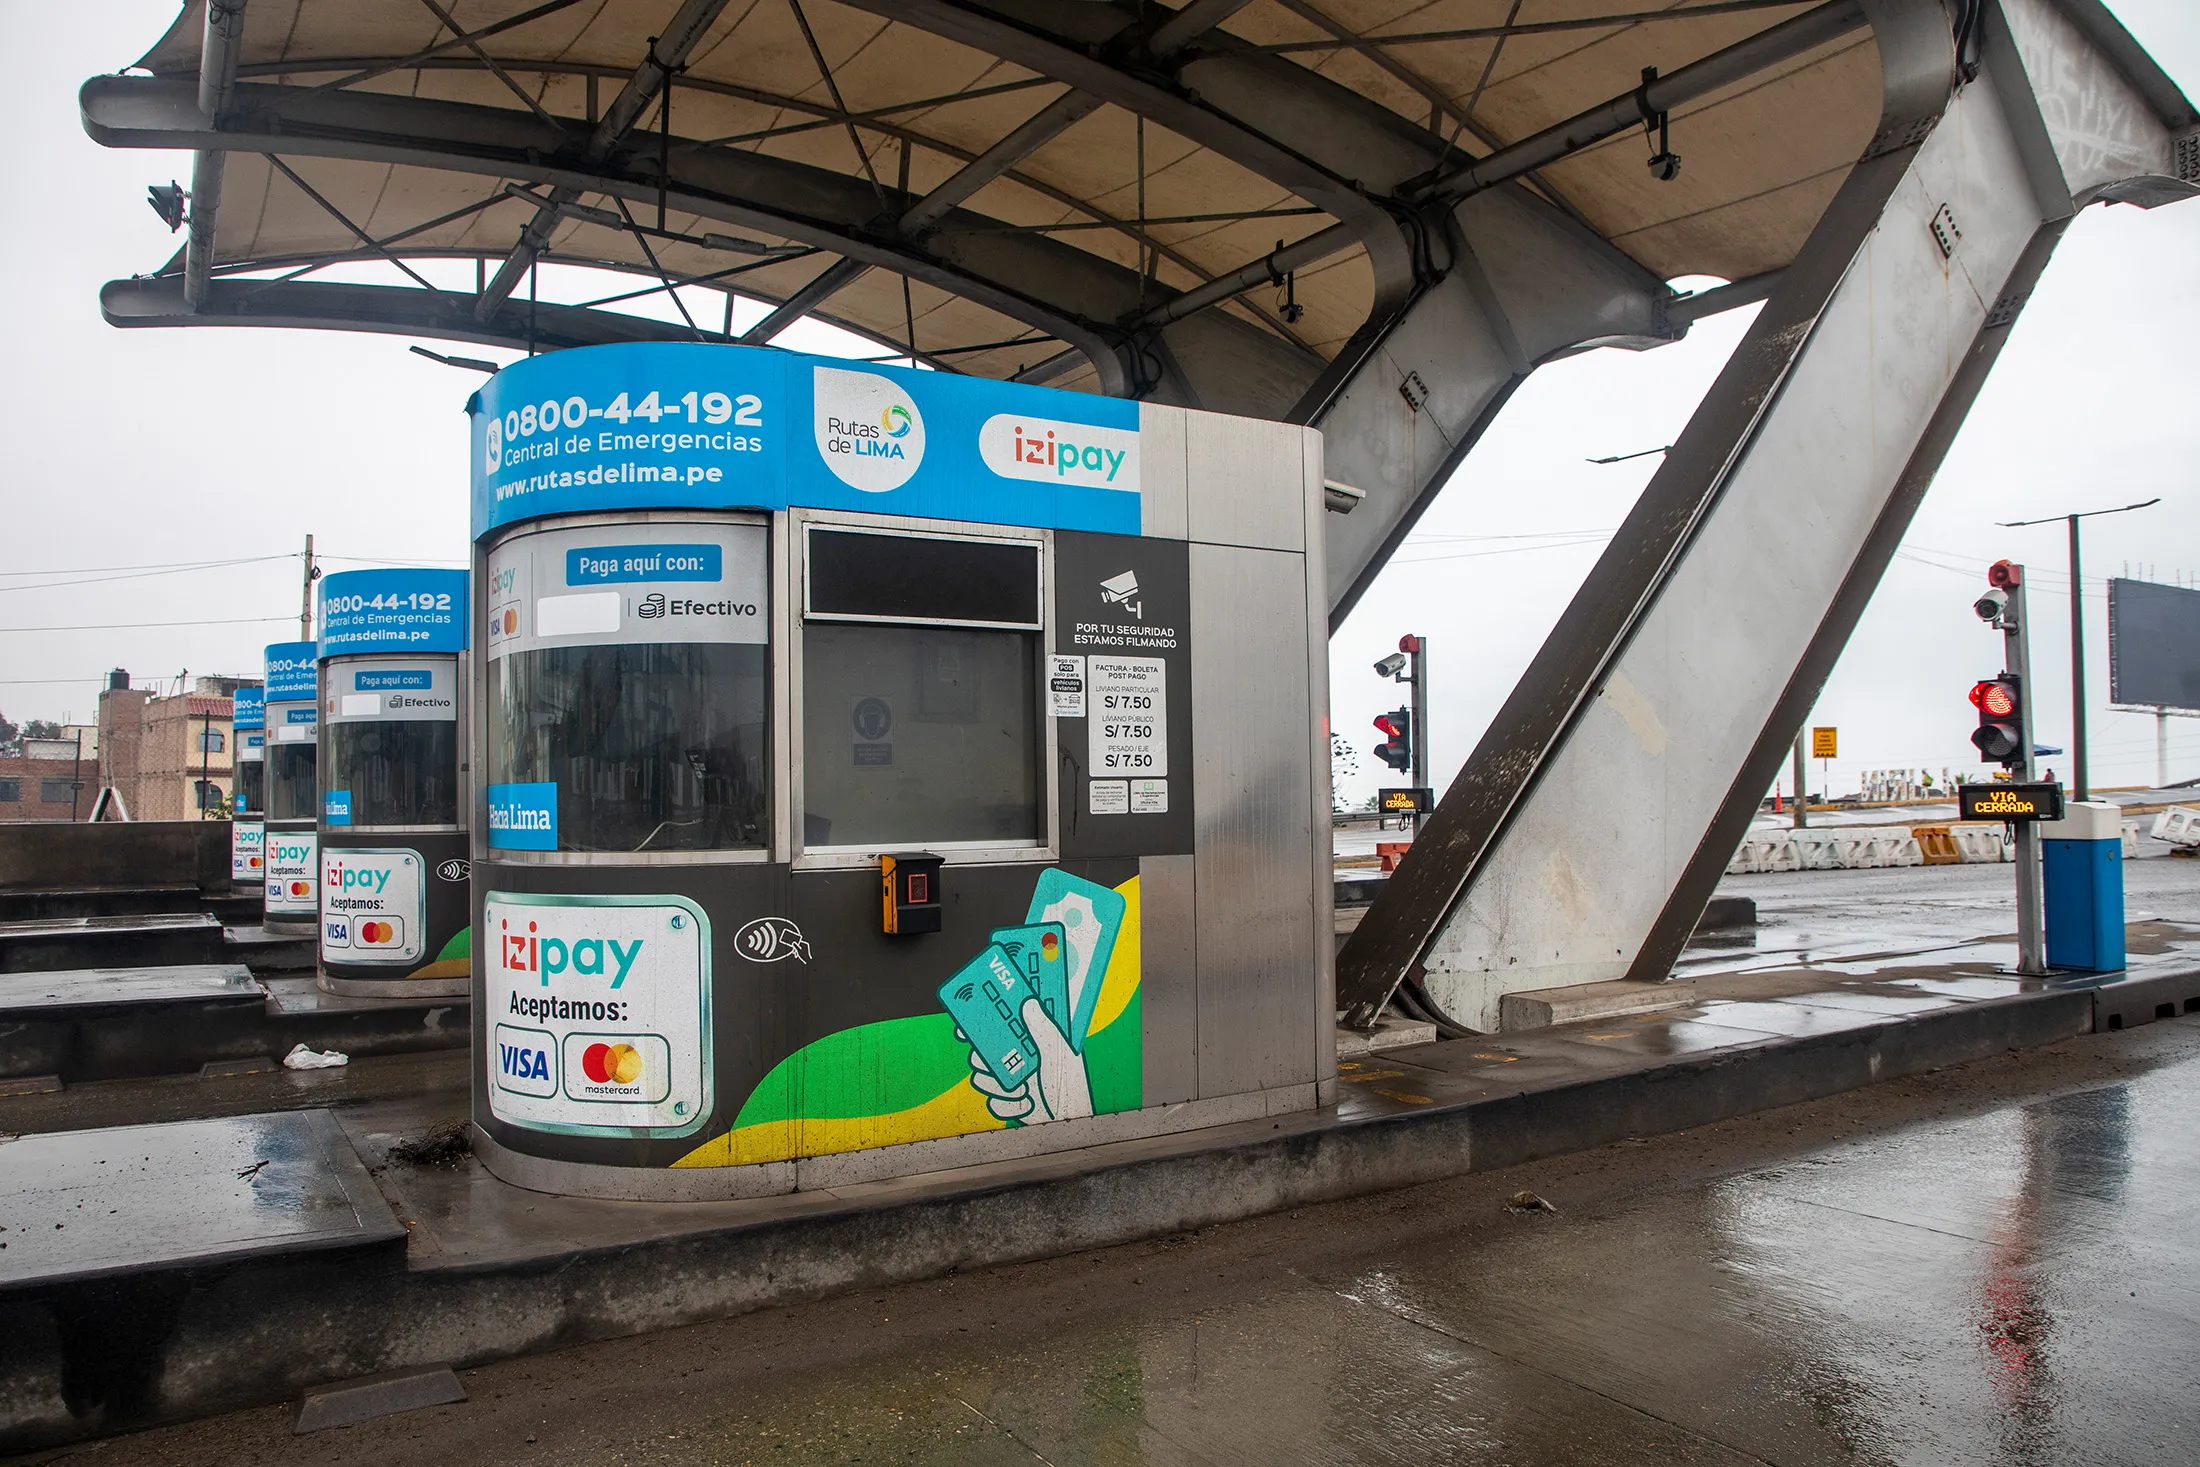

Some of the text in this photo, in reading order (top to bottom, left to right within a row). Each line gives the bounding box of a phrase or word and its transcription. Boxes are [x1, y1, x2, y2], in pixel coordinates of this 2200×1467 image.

[505, 391, 762, 441] 0800-44-192
[828, 417, 880, 438] Rutas
[505, 431, 762, 466] Central de Emergencias
[828, 436, 904, 460] de LIMA
[1014, 426, 1126, 482] izipay
[496, 462, 723, 502] www.rutasdelima.pe
[579, 553, 704, 579] Paga aquí con:
[327, 593, 451, 615] 0800-44-192
[670, 599, 757, 617] Efectivo
[352, 614, 365, 625] de
[367, 613, 451, 625] Emergencias
[1076, 623, 1175, 637] POR TU SEGURIDAD
[1074, 634, 1177, 648] ESTAMOS FILMANDO
[361, 675, 423, 687] Paga aquí con:
[1108, 672, 1147, 681] POST PAGO
[405, 698, 451, 707] Efectivo
[1104, 695, 1152, 709] S/ 7.50
[1102, 715, 1128, 723] LIVIANO
[1105, 724, 1152, 739] S/ 7.50
[1105, 754, 1153, 768] S/ 7.50
[1385, 800, 1415, 808] CERRADA
[1393, 793, 1406, 801] VIA
[1990, 792, 2017, 802] VIA
[1974, 801, 2035, 813] CERRADA
[510, 803, 551, 830] Lima
[268, 841, 311, 864] izipay
[270, 866, 306, 877] Aceptamos:
[327, 861, 392, 894] izipay
[268, 884, 282, 896] VISA
[330, 896, 384, 911] Aceptamos:
[326, 923, 348, 940] VISA
[501, 918, 645, 989] izipay
[988, 953, 1016, 991] VISA
[509, 990, 628, 1023] Aceptamos:
[499, 1043, 550, 1081] VISA
[585, 1085, 640, 1096] mastercard
